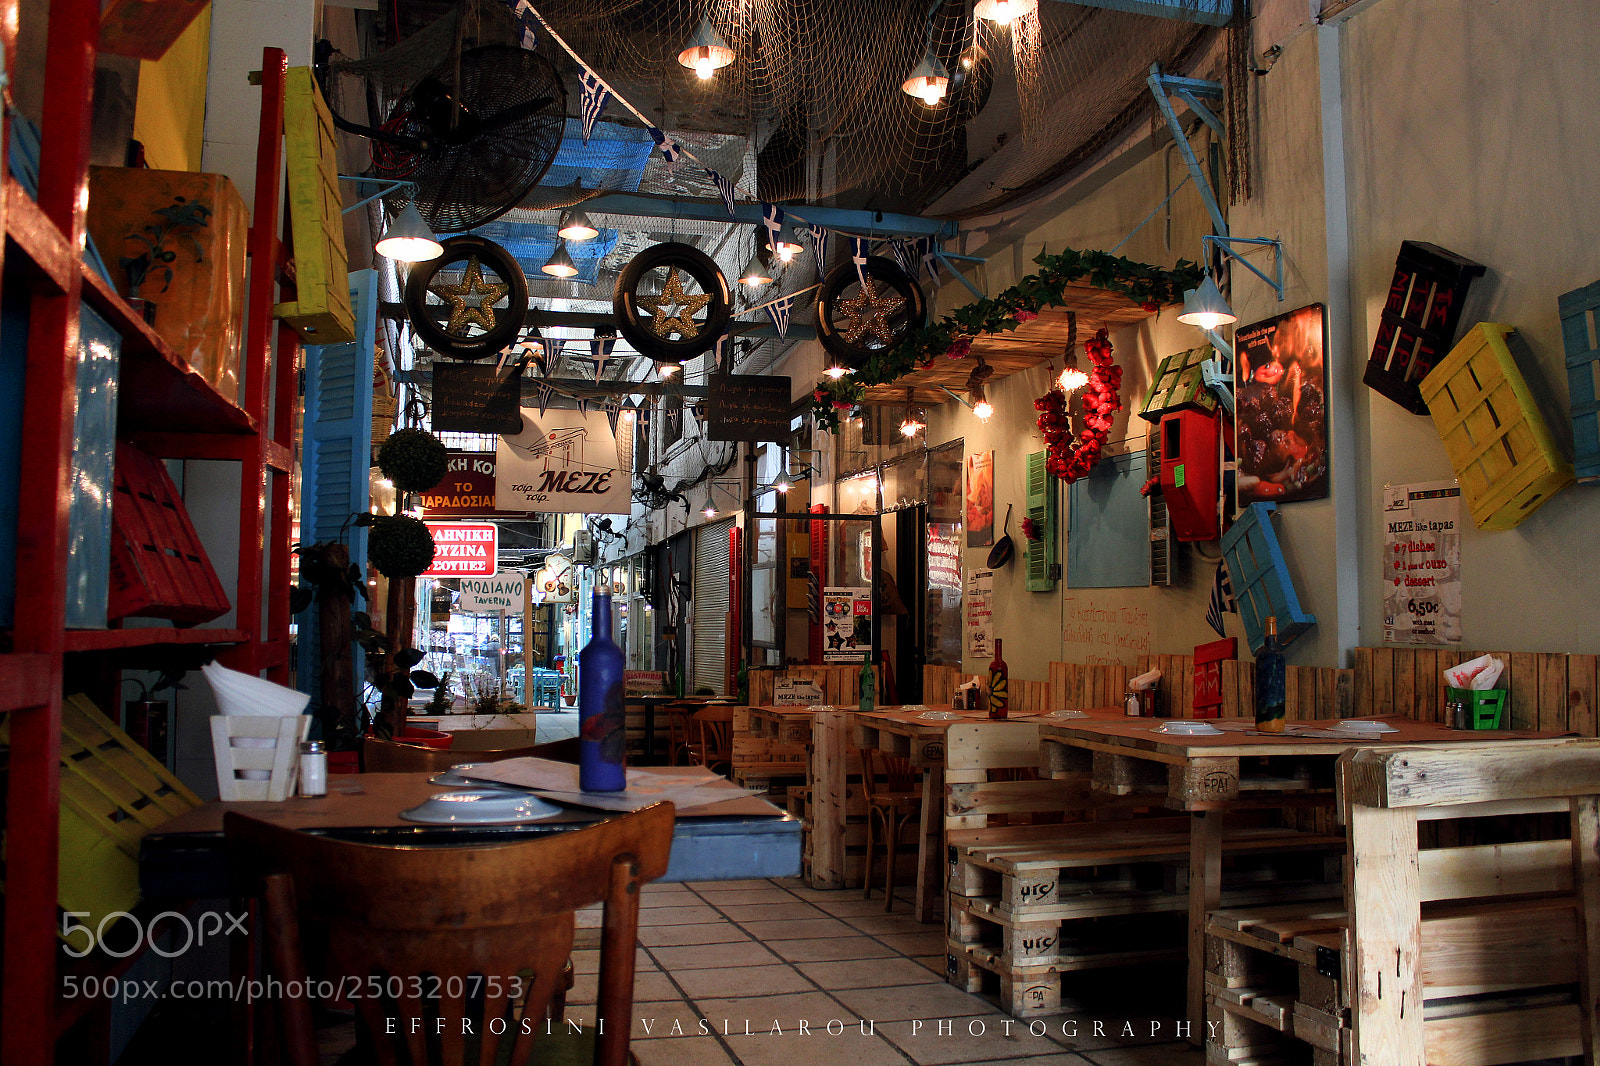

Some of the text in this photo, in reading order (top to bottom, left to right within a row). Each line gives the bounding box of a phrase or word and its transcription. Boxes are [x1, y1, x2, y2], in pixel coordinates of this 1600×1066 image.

[447, 459, 468, 472] ΚΗ
[454, 482, 473, 492] ΤΟ
[1388, 520, 1454, 533] MEZE like tapas
[433, 529, 494, 542] ΛΗΝΙΚΗ
[433, 544, 487, 557] ΟΥΖΙΝΑ
[1402, 544, 1407, 555] 7
[1408, 540, 1436, 553] dishes
[1425, 559, 1447, 570] ouzo
[1404, 574, 1436, 587] dessert
